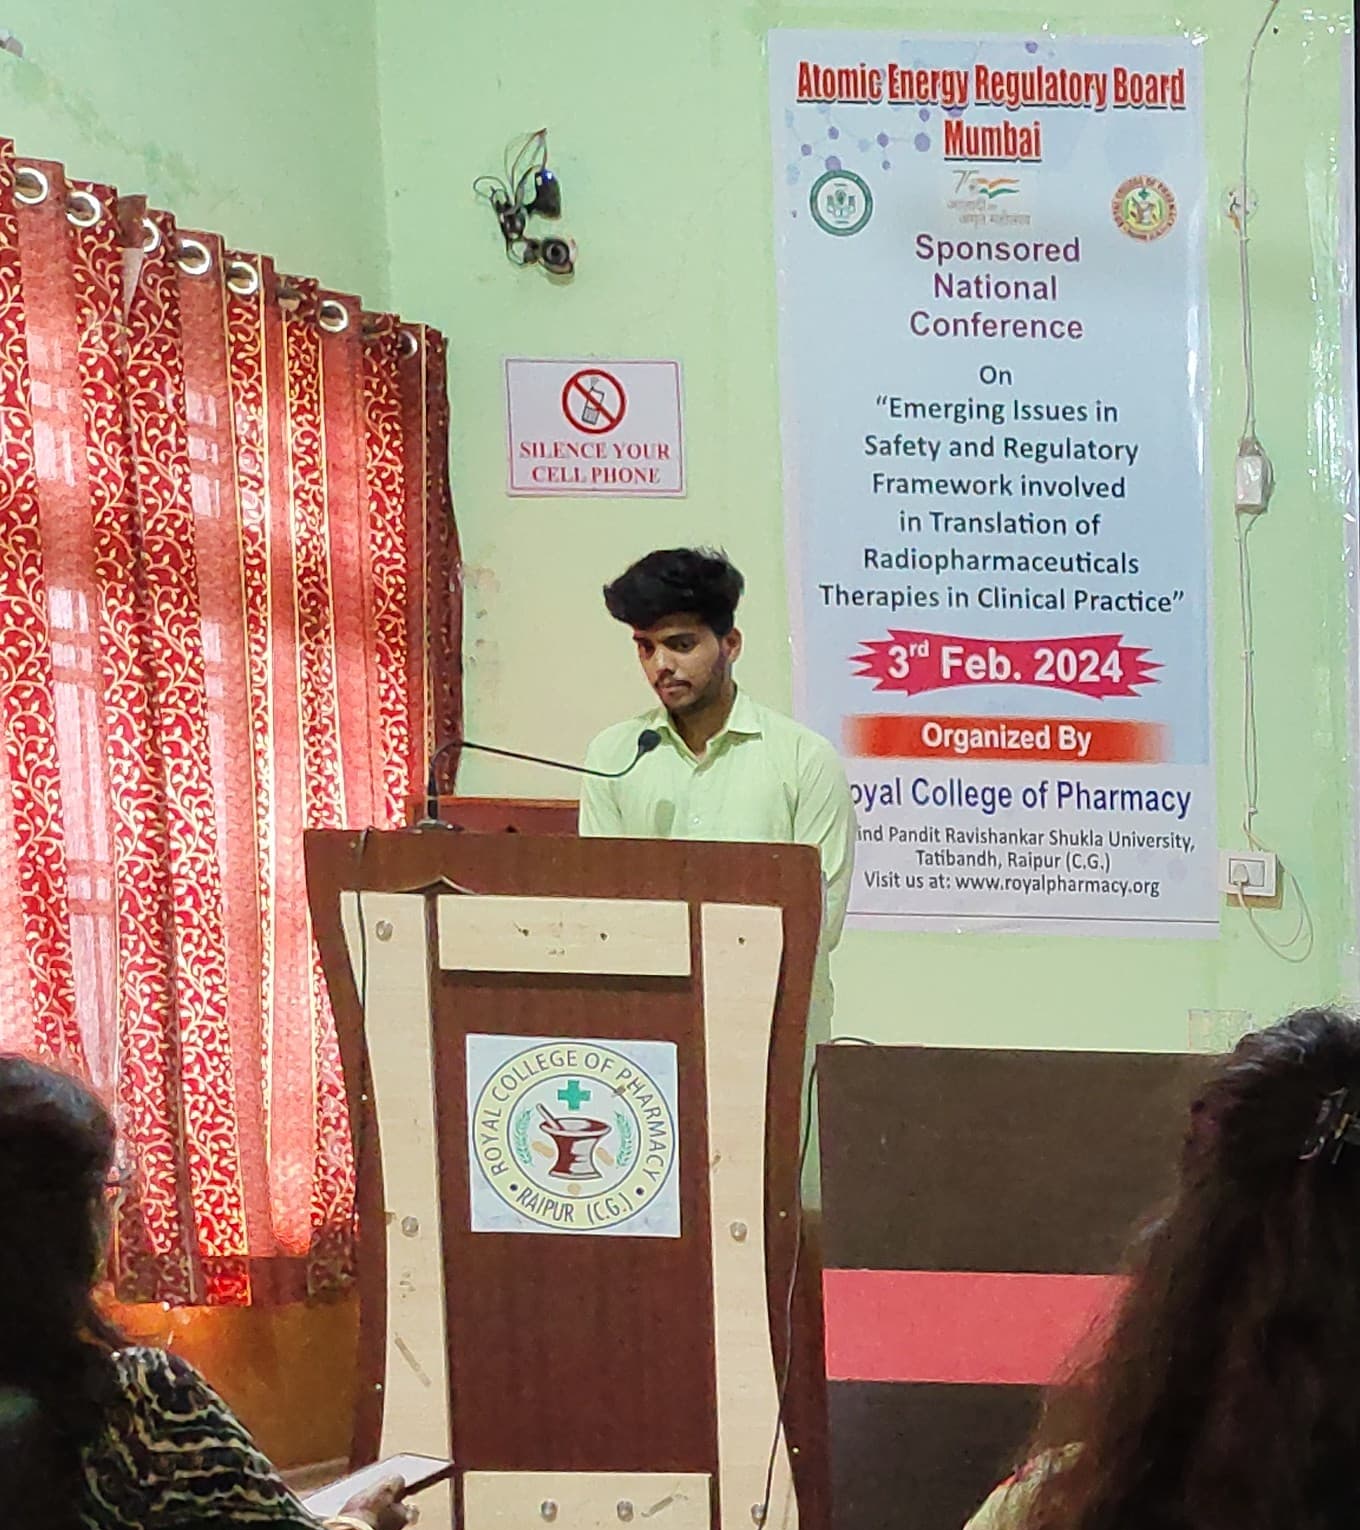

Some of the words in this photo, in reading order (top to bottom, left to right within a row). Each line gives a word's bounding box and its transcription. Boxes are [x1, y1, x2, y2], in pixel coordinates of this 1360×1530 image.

[797, 61, 882, 104] Atomic
[887, 63, 968, 108] Energy
[974, 64, 1108, 112] Regulatory
[1113, 67, 1186, 106] Board
[943, 120, 1043, 158] Mumbai
[915, 234, 1080, 266] Sponsored
[934, 273, 1058, 301] National
[910, 312, 1084, 340] Conference
[979, 366, 1012, 385] On
[1013, 400, 1088, 421] Issues
[1096, 400, 1118, 422] in
[520, 441, 608, 459] SILENCE
[612, 443, 670, 459] YOUR
[864, 435, 939, 460] Safety
[949, 438, 994, 458] and
[1004, 438, 1138, 465] Regulatory
[532, 466, 586, 483] CELL
[591, 468, 660, 484] PHONE
[872, 473, 1012, 496] Framework
[1020, 475, 1125, 498] involved
[899, 511, 920, 532] in
[930, 511, 1068, 536] Translation
[1076, 513, 1101, 535] of
[863, 548, 1139, 575] Radiopharmaceuticals
[820, 585, 940, 610] Therapies
[947, 587, 969, 608] in
[977, 586, 1065, 610] Clinical
[887, 641, 929, 678] 3rd
[941, 646, 1022, 680] Feb.
[1034, 647, 1123, 682] 2024
[921, 721, 1051, 753] Organized
[1058, 725, 1091, 755] By
[850, 777, 901, 812] oyal
[911, 777, 1012, 814] College
[1022, 780, 1050, 810] of
[1057, 782, 1192, 819] Pharmacy
[888, 826, 941, 843] Pandit
[945, 827, 1045, 846] Ravishankar
[1049, 829, 1103, 847] Shukla
[1108, 831, 1195, 851] University,
[916, 850, 1002, 868] Tatibandh,
[1007, 852, 1061, 872] Raipur
[1065, 852, 1110, 872] (C.G.)
[864, 871, 902, 889] Visit
[907, 876, 925, 890] us
[929, 874, 951, 890] at:
[955, 875, 1160, 897] www.royalpharmacy.org
[492, 1050, 577, 1102] COLLEGE
[585, 1052, 615, 1073] OF
[616, 1068, 666, 1183] PHARMACY
[481, 1108, 509, 1177] ROYAL
[516, 1187, 574, 1222] RAIPUR
[587, 1192, 633, 1225] (C.G.)
